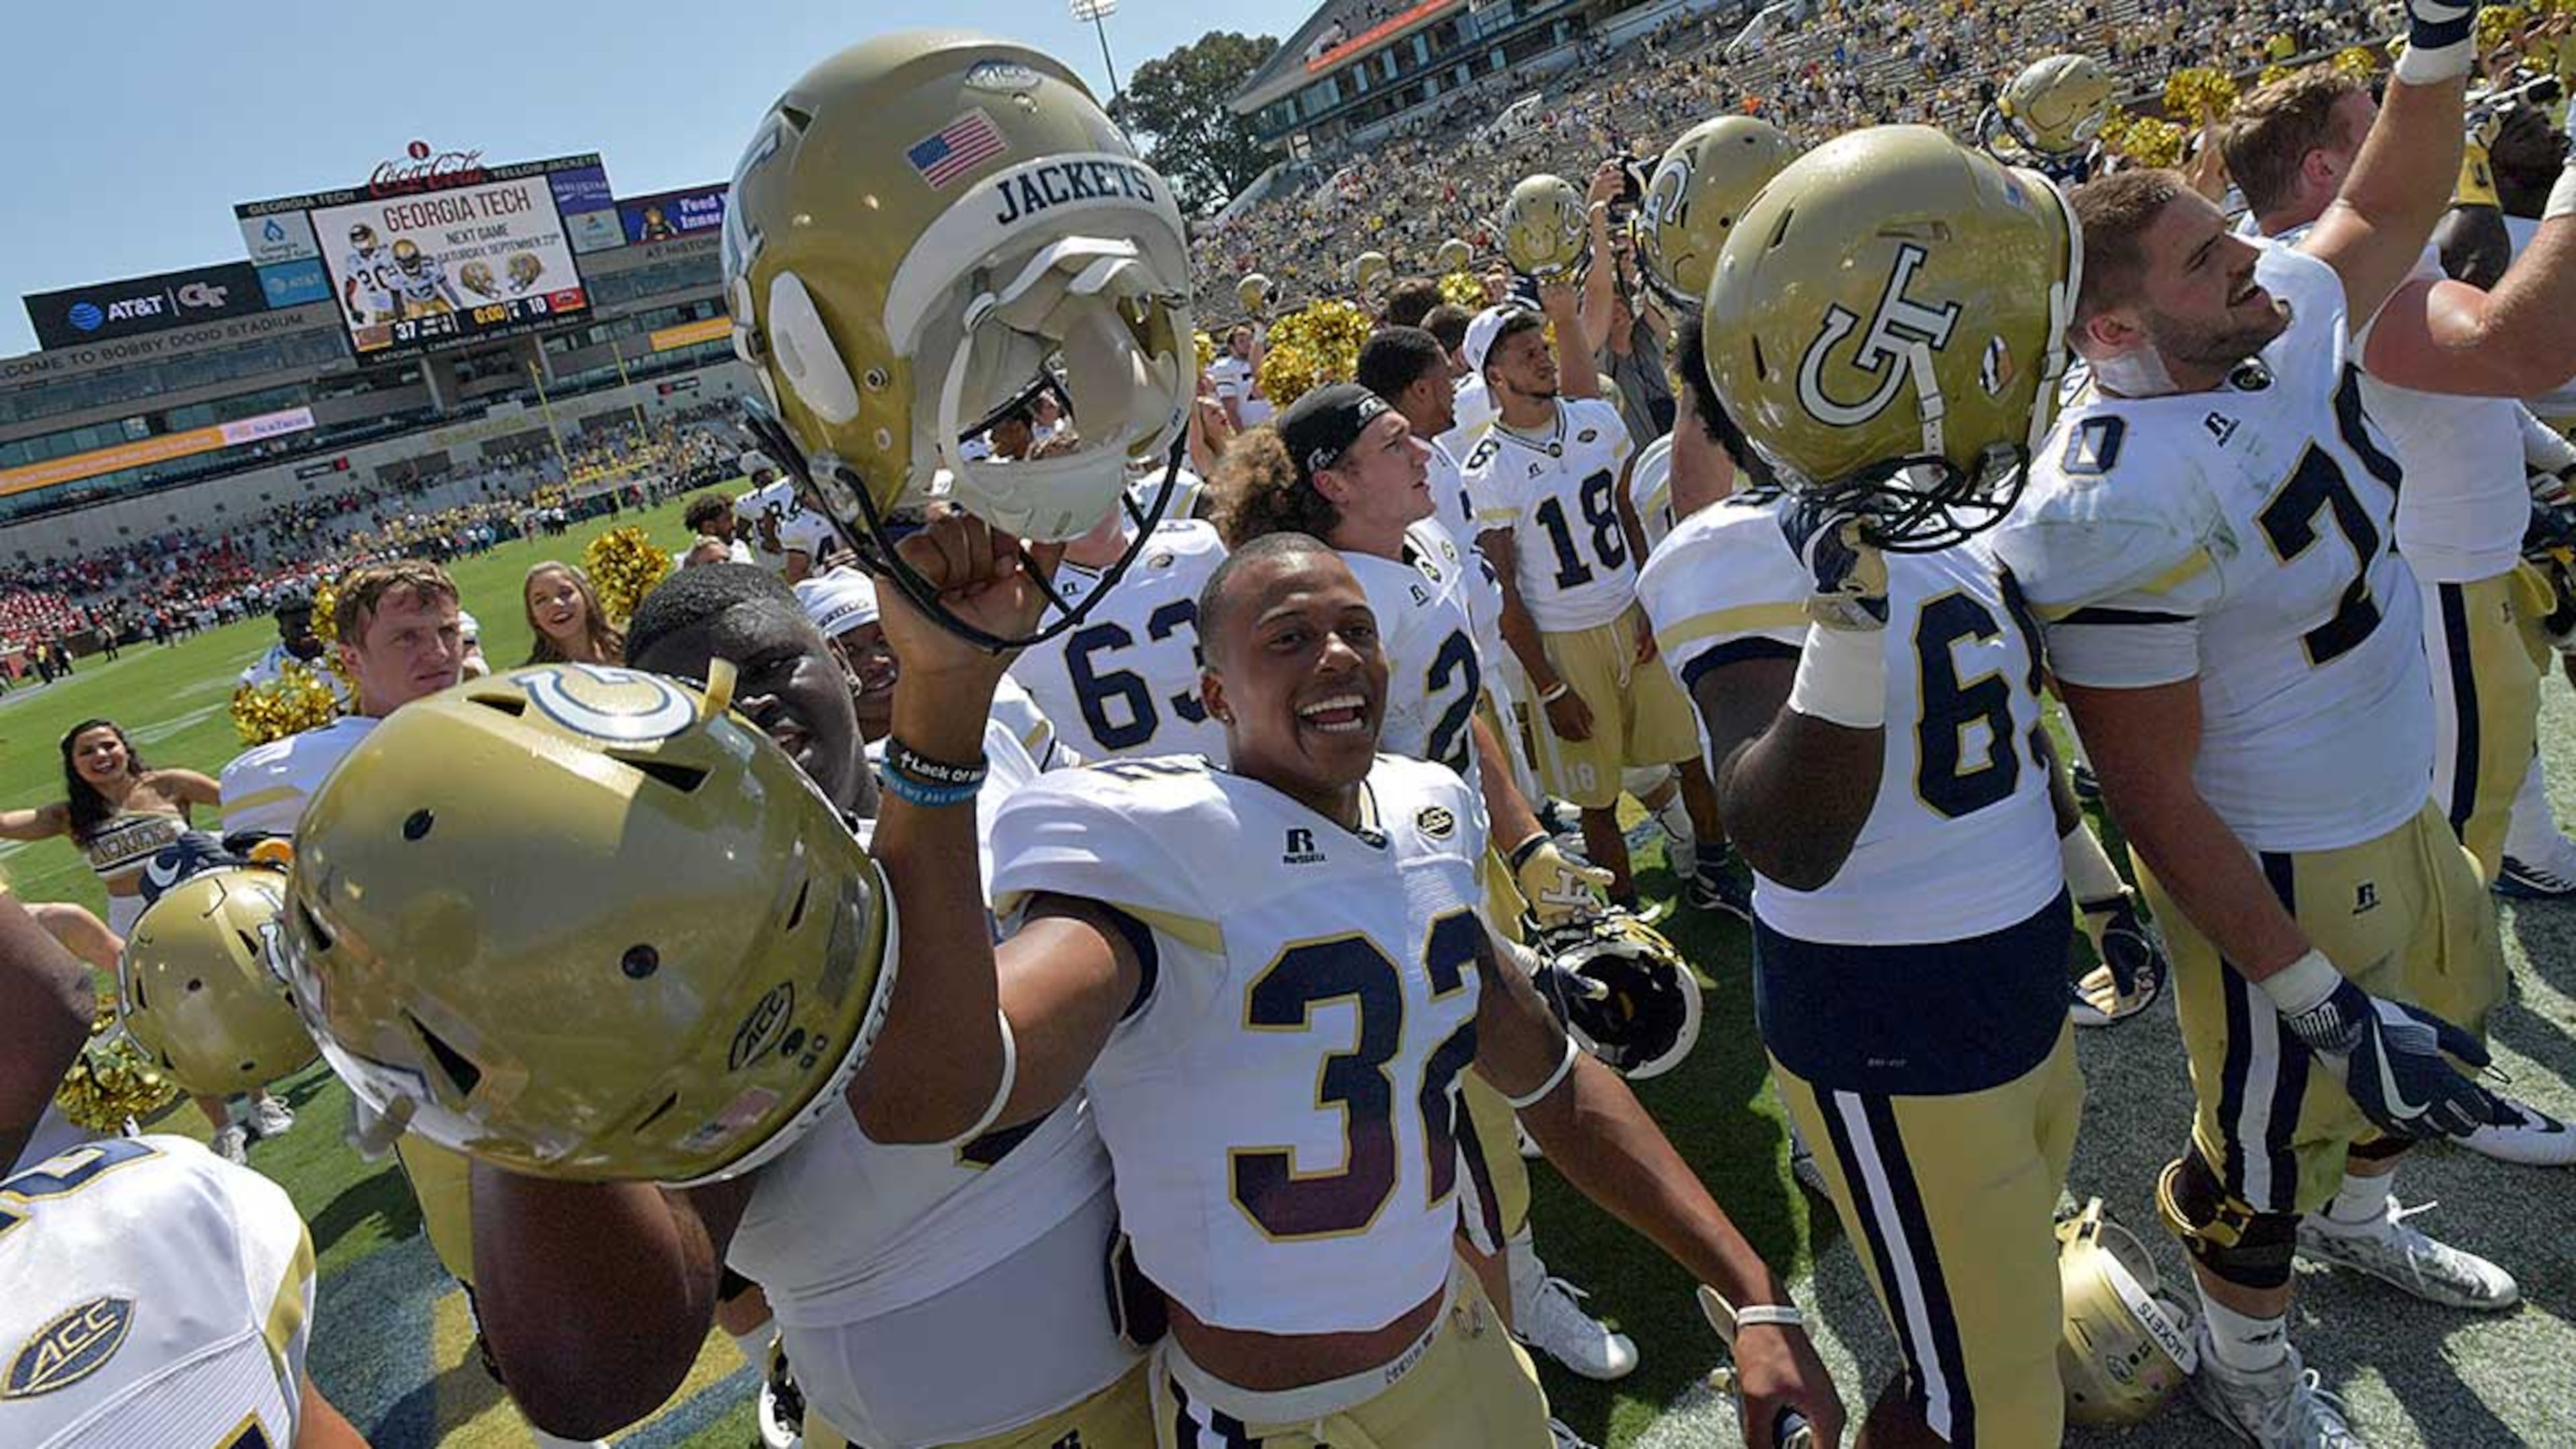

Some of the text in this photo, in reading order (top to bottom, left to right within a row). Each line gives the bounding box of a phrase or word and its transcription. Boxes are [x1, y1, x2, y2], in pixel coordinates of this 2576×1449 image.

[370, 149, 486, 197] Coca-Cola
[493, 156, 600, 178] YELLOW JACKETS
[247, 191, 356, 215] GEORGIA TECH
[384, 187, 531, 232] GEORGIA TECH
[997, 159, 1155, 225] JACKETS
[446, 222, 510, 246] NEXT GAME
[109, 294, 163, 321] AT&T
[473, 305, 504, 325] 0:00
[527, 296, 547, 315] 10
[0, 313, 307, 380] COME TO BOBBY DODD STADIUM
[394, 321, 417, 339] 37
[1796, 242, 1962, 427] GT
[1536, 469, 1627, 591] 18
[1064, 598, 1205, 751] 63
[1913, 588, 2046, 820] 6
[911, 755, 950, 781] Lack
[1566, 761, 1596, 792] 18
[1287, 828, 1314, 853] R
[743, 990, 784, 1059] ACC
[1228, 905, 1478, 1242] 32
[31, 1296, 119, 1381] ACC
[2137, 1301, 2188, 1362] JACKETS
